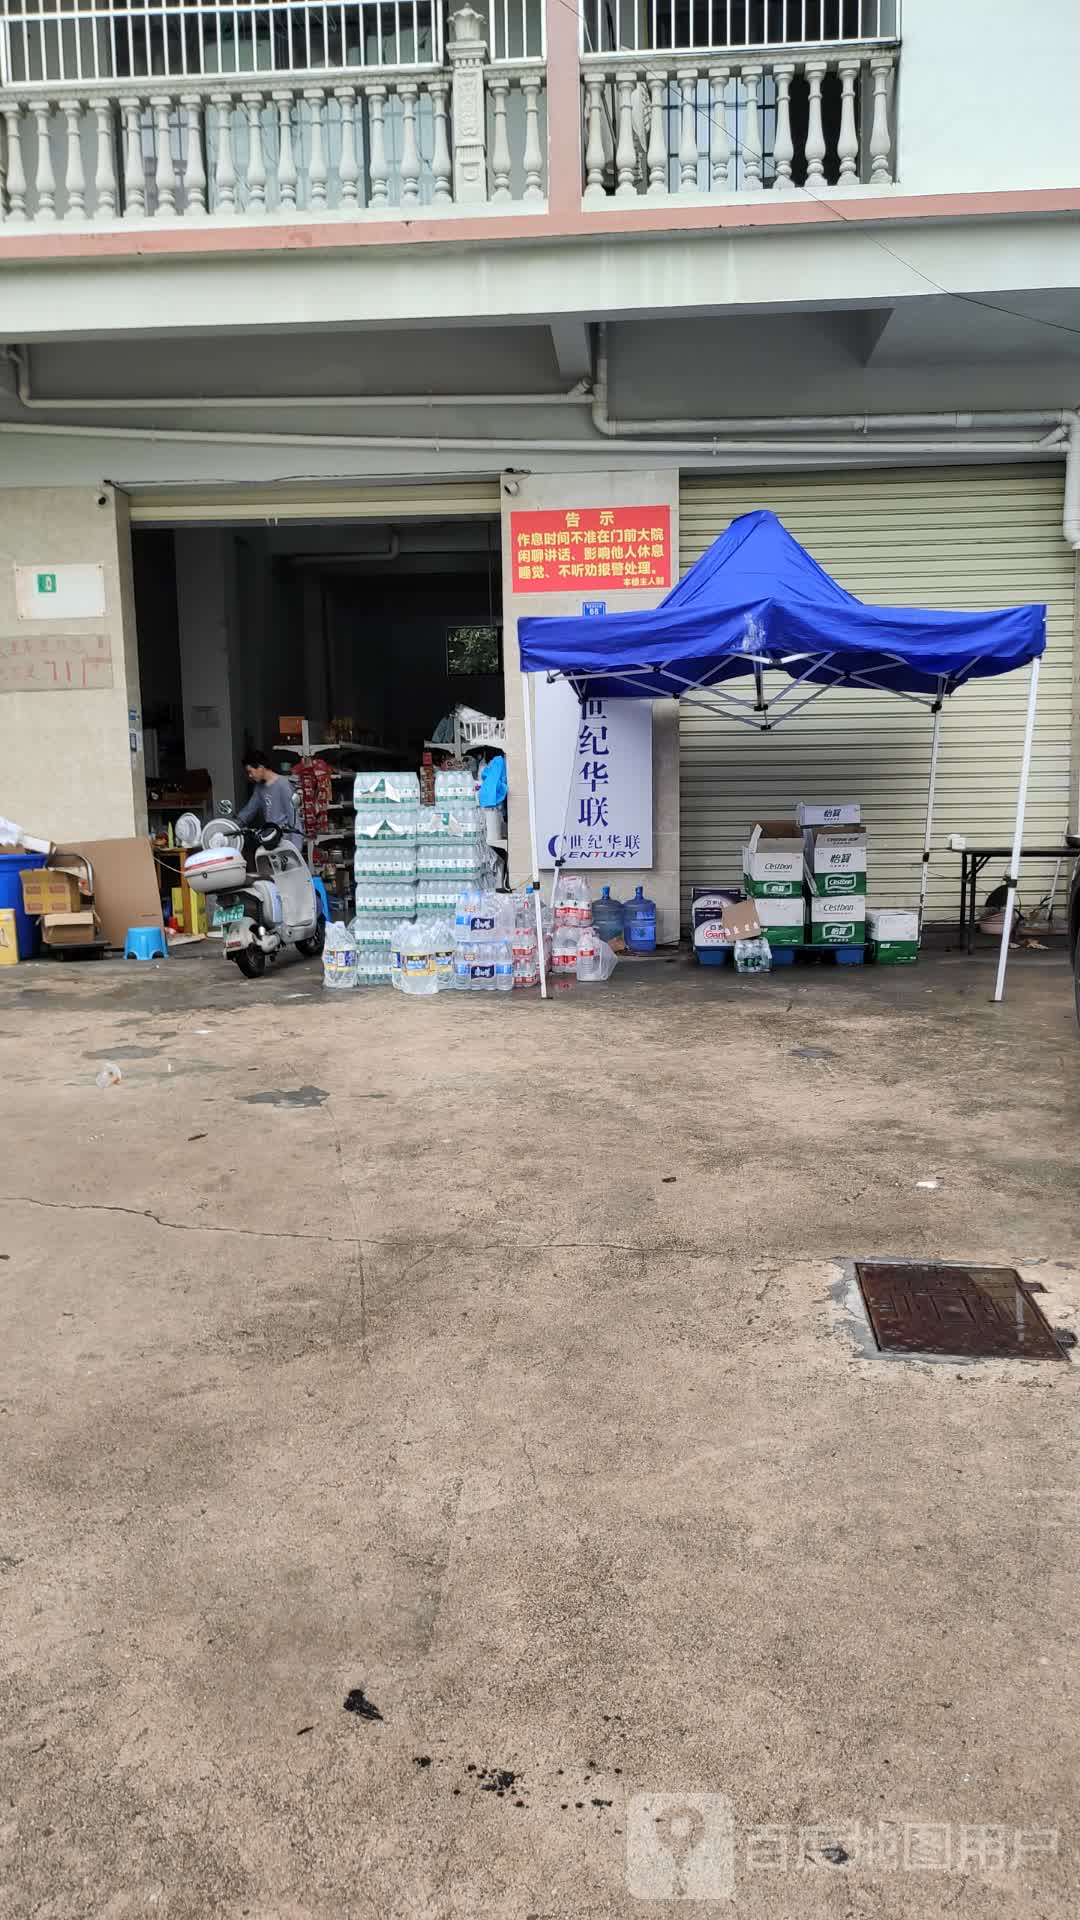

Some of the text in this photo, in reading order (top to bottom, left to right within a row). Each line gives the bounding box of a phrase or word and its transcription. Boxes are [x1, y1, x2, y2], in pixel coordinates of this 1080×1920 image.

[517, 528, 664, 547] 作息时间不准在门前大院
[517, 544, 664, 563] 闲聊讲话、影响他人休息
[570, 834, 640, 850] 世纪华联
